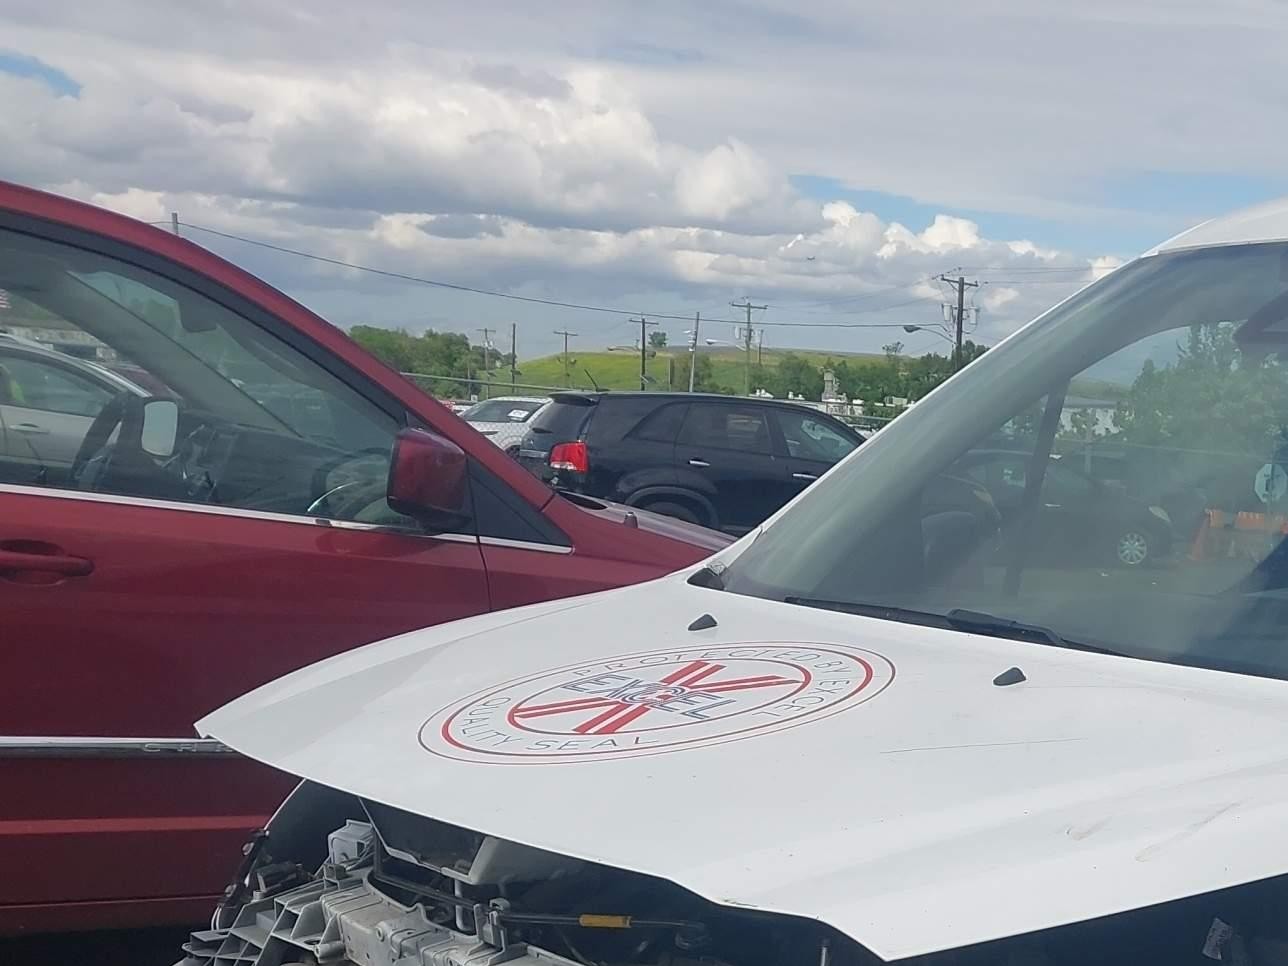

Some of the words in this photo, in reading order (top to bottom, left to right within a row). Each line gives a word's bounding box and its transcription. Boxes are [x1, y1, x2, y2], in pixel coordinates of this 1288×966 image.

[562, 674, 737, 719] EXCEL
[573, 649, 821, 676] PROTECTED
[752, 679, 850, 717] EXCEL
[462, 697, 522, 746] QUALITY
[527, 736, 660, 751] SEAL
